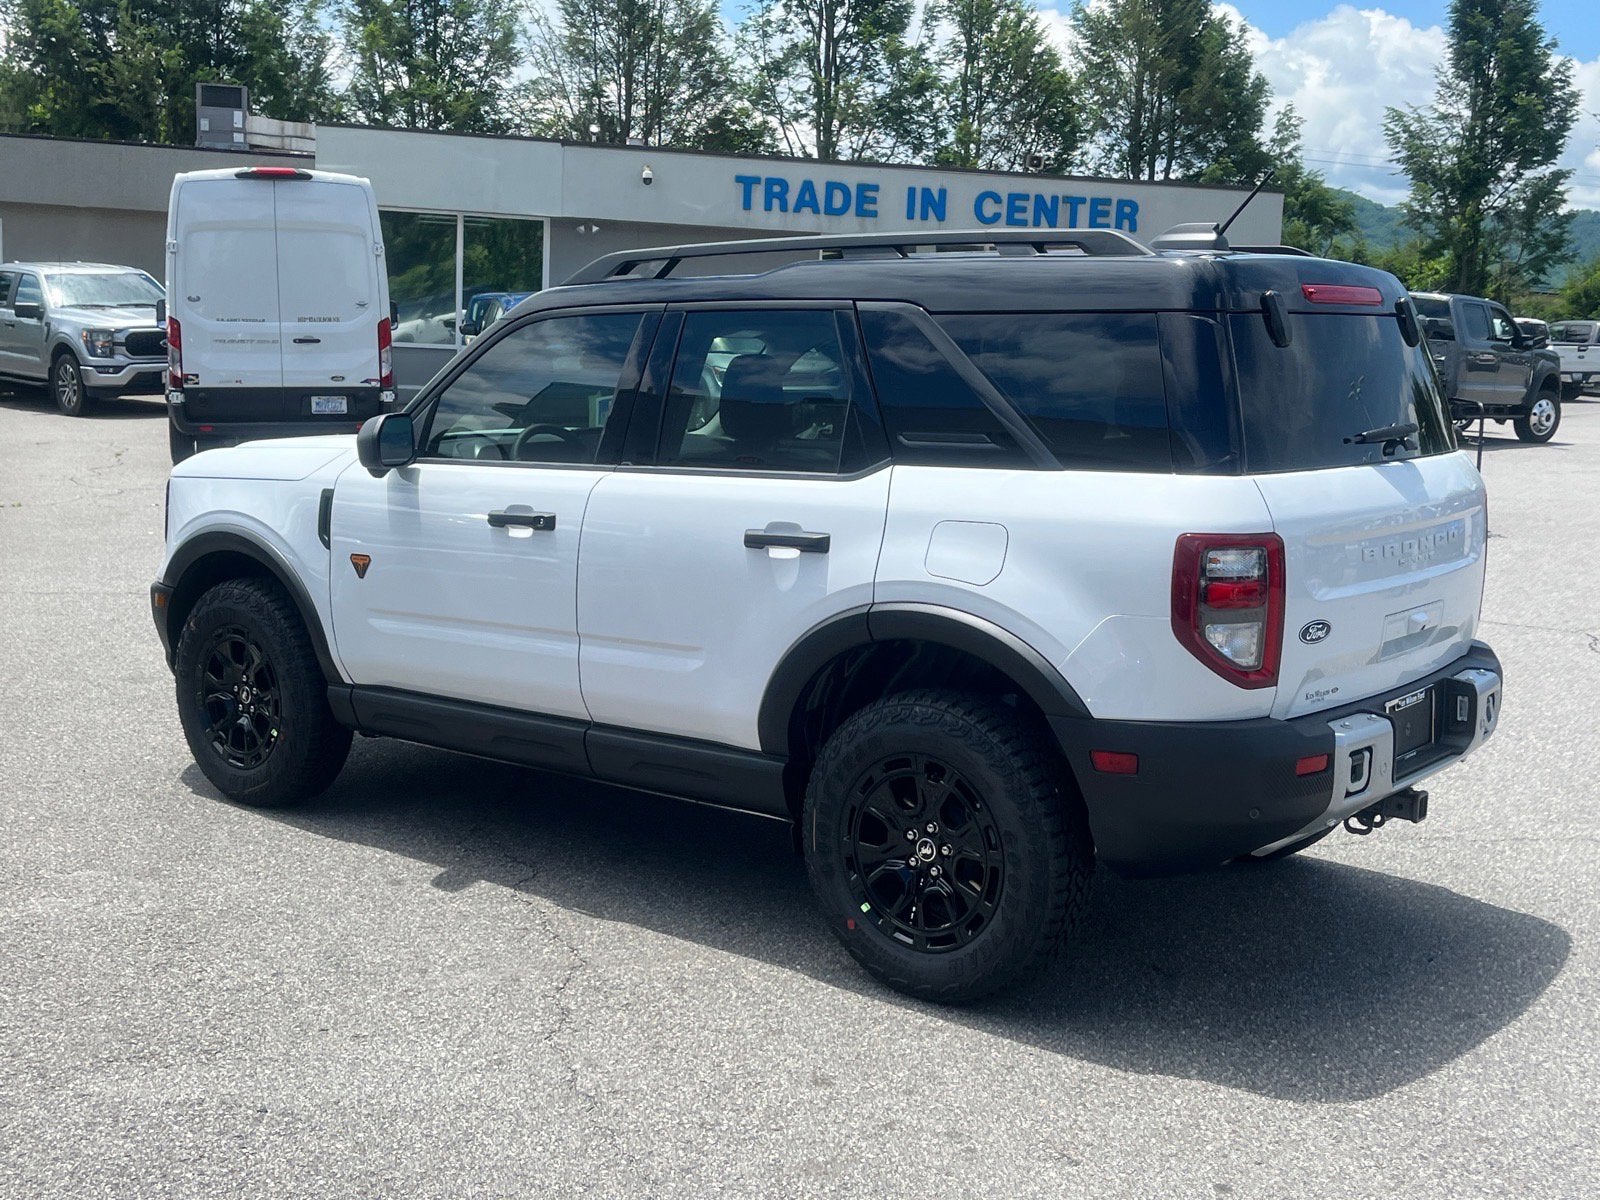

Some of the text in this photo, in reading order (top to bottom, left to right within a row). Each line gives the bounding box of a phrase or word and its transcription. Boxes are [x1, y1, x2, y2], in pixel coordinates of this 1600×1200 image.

[735, 174, 1140, 233] TRADE IN CENTER
[1361, 529, 1458, 562] BRONCO
[1304, 622, 1329, 641] Ford
